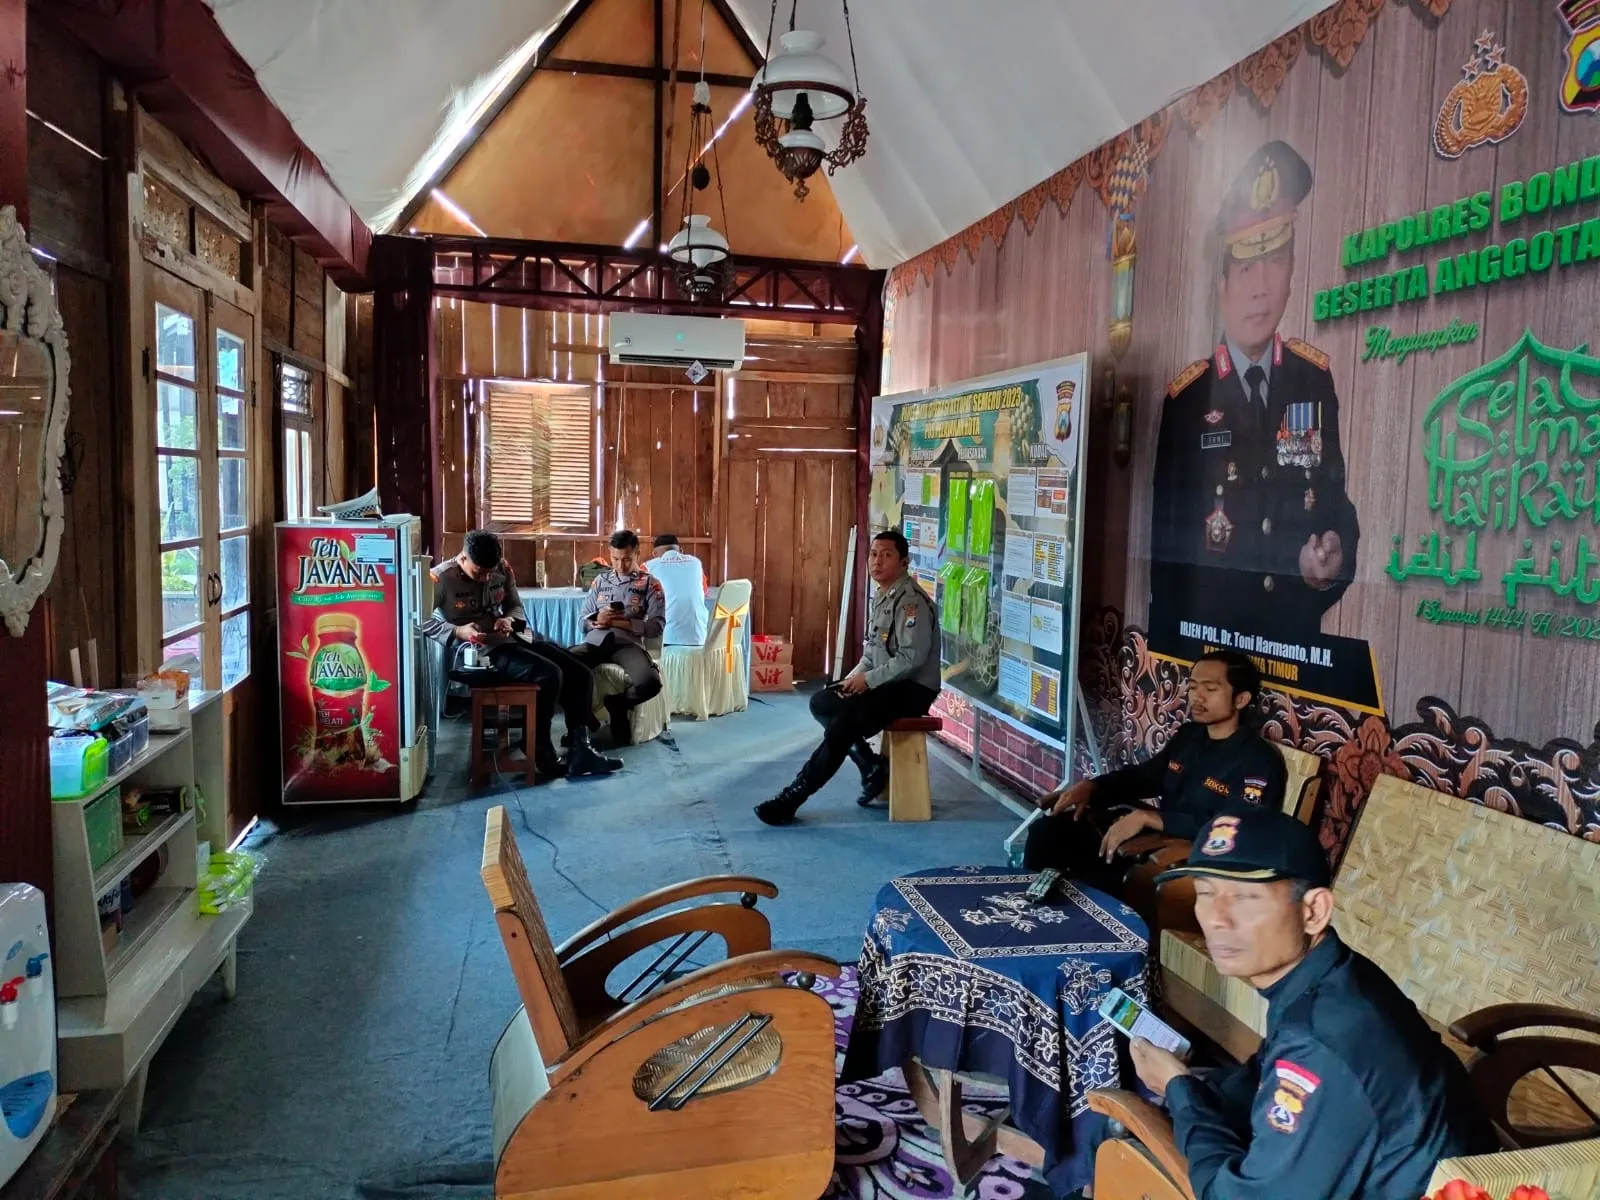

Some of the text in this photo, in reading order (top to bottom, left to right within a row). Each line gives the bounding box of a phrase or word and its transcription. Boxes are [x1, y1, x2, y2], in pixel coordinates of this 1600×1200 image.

[1342, 191, 1492, 268] KAPOLRES
[1313, 218, 1600, 320] BESERTA ANGGOTA
[973, 388, 1000, 413] SEMERU
[1001, 384, 1022, 410] 2023
[311, 537, 340, 558] Teh
[294, 556, 384, 593] JAVANA
[755, 644, 784, 662] Vit
[1180, 621, 1201, 638] IRJEN
[1202, 626, 1219, 643] POL.
[1221, 629, 1233, 646] Dr.
[1234, 632, 1254, 651] Toni
[1256, 636, 1308, 664] Harmanto,
[1310, 646, 1333, 667] M.H.
[323, 651, 340, 662] Teh
[313, 662, 363, 684] JAVANA
[755, 667, 785, 685] Vit
[1267, 660, 1298, 681] TIMUR
